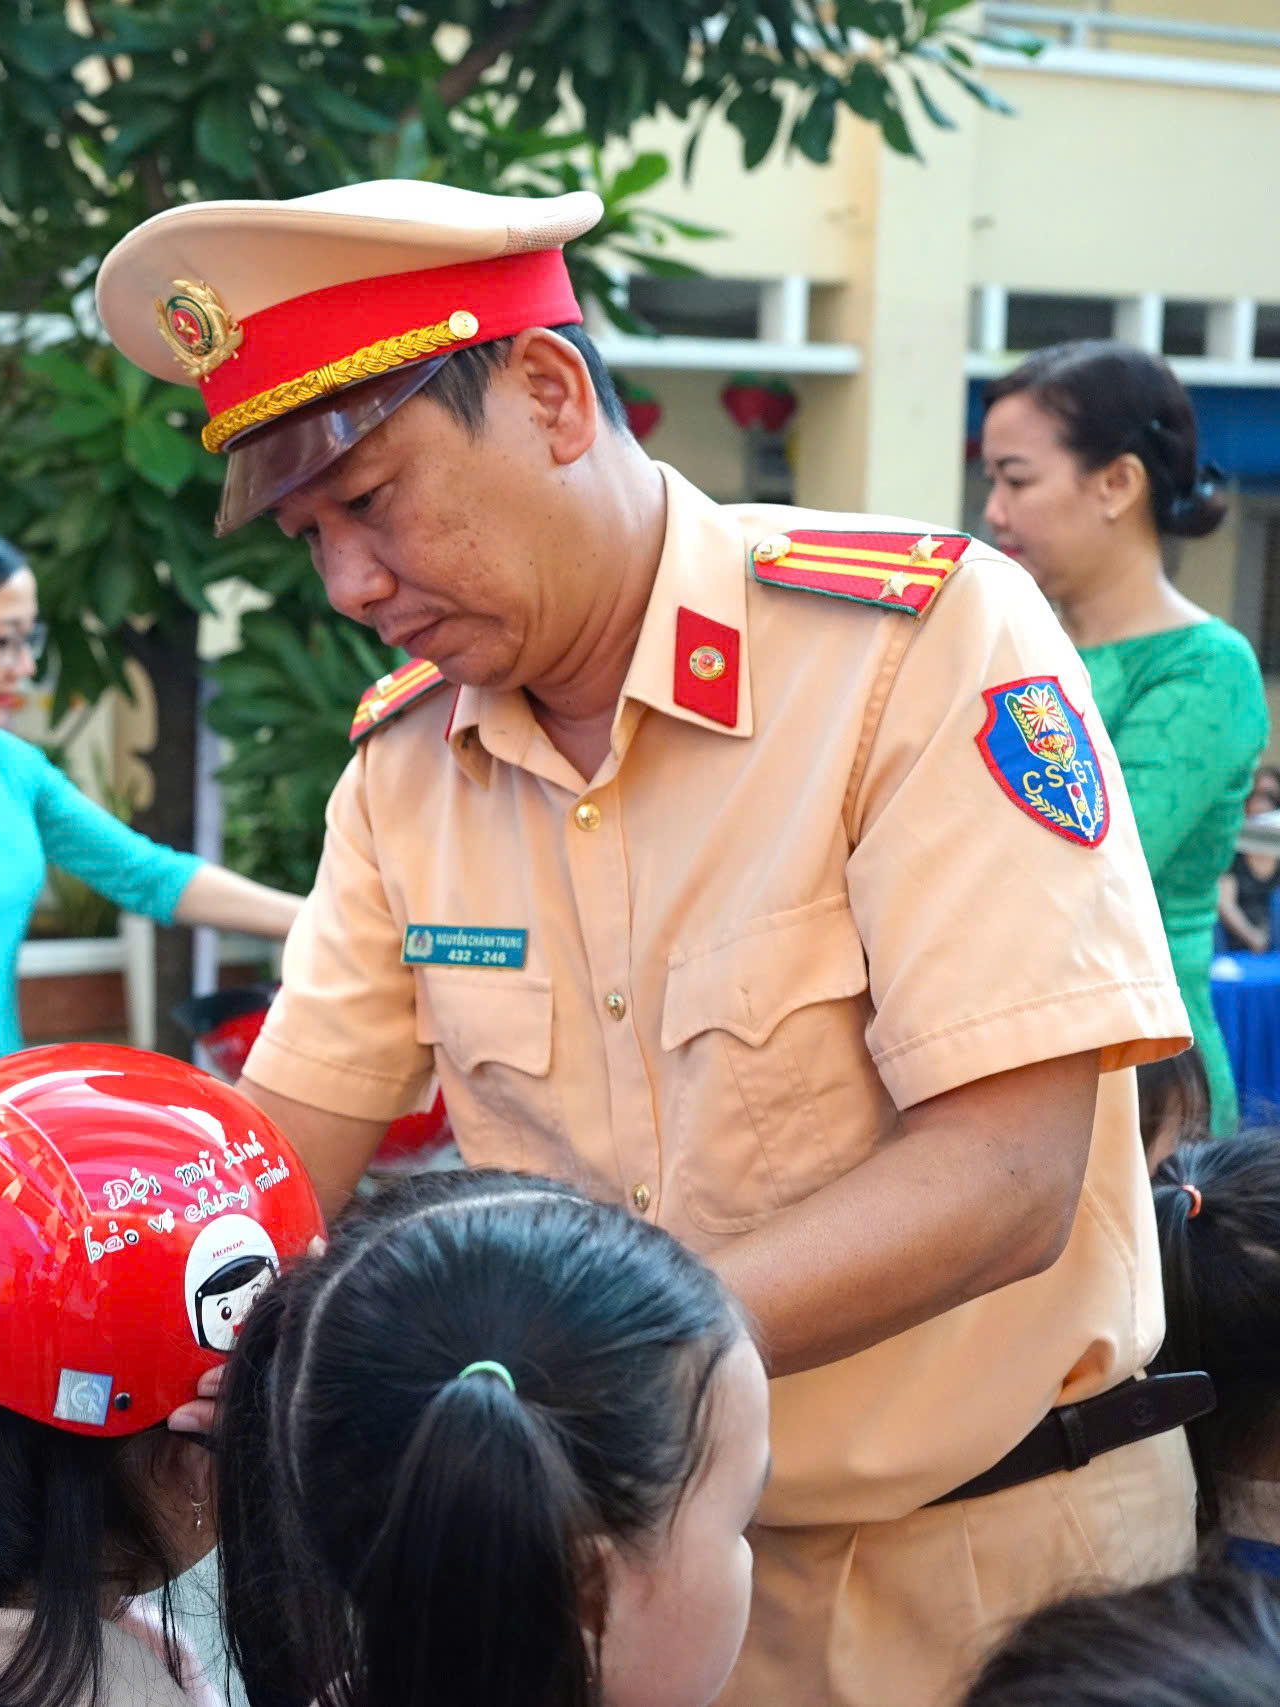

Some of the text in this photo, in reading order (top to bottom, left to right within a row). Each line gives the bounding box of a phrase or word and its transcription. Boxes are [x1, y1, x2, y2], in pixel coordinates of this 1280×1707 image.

[1022, 760, 1097, 795] CSGT
[447, 949, 472, 963] 432
[482, 951, 507, 964] 246
[175, 1150, 215, 1187] mũ
[184, 1180, 249, 1223] chúng
[212, 1239, 245, 1259] HONDA
